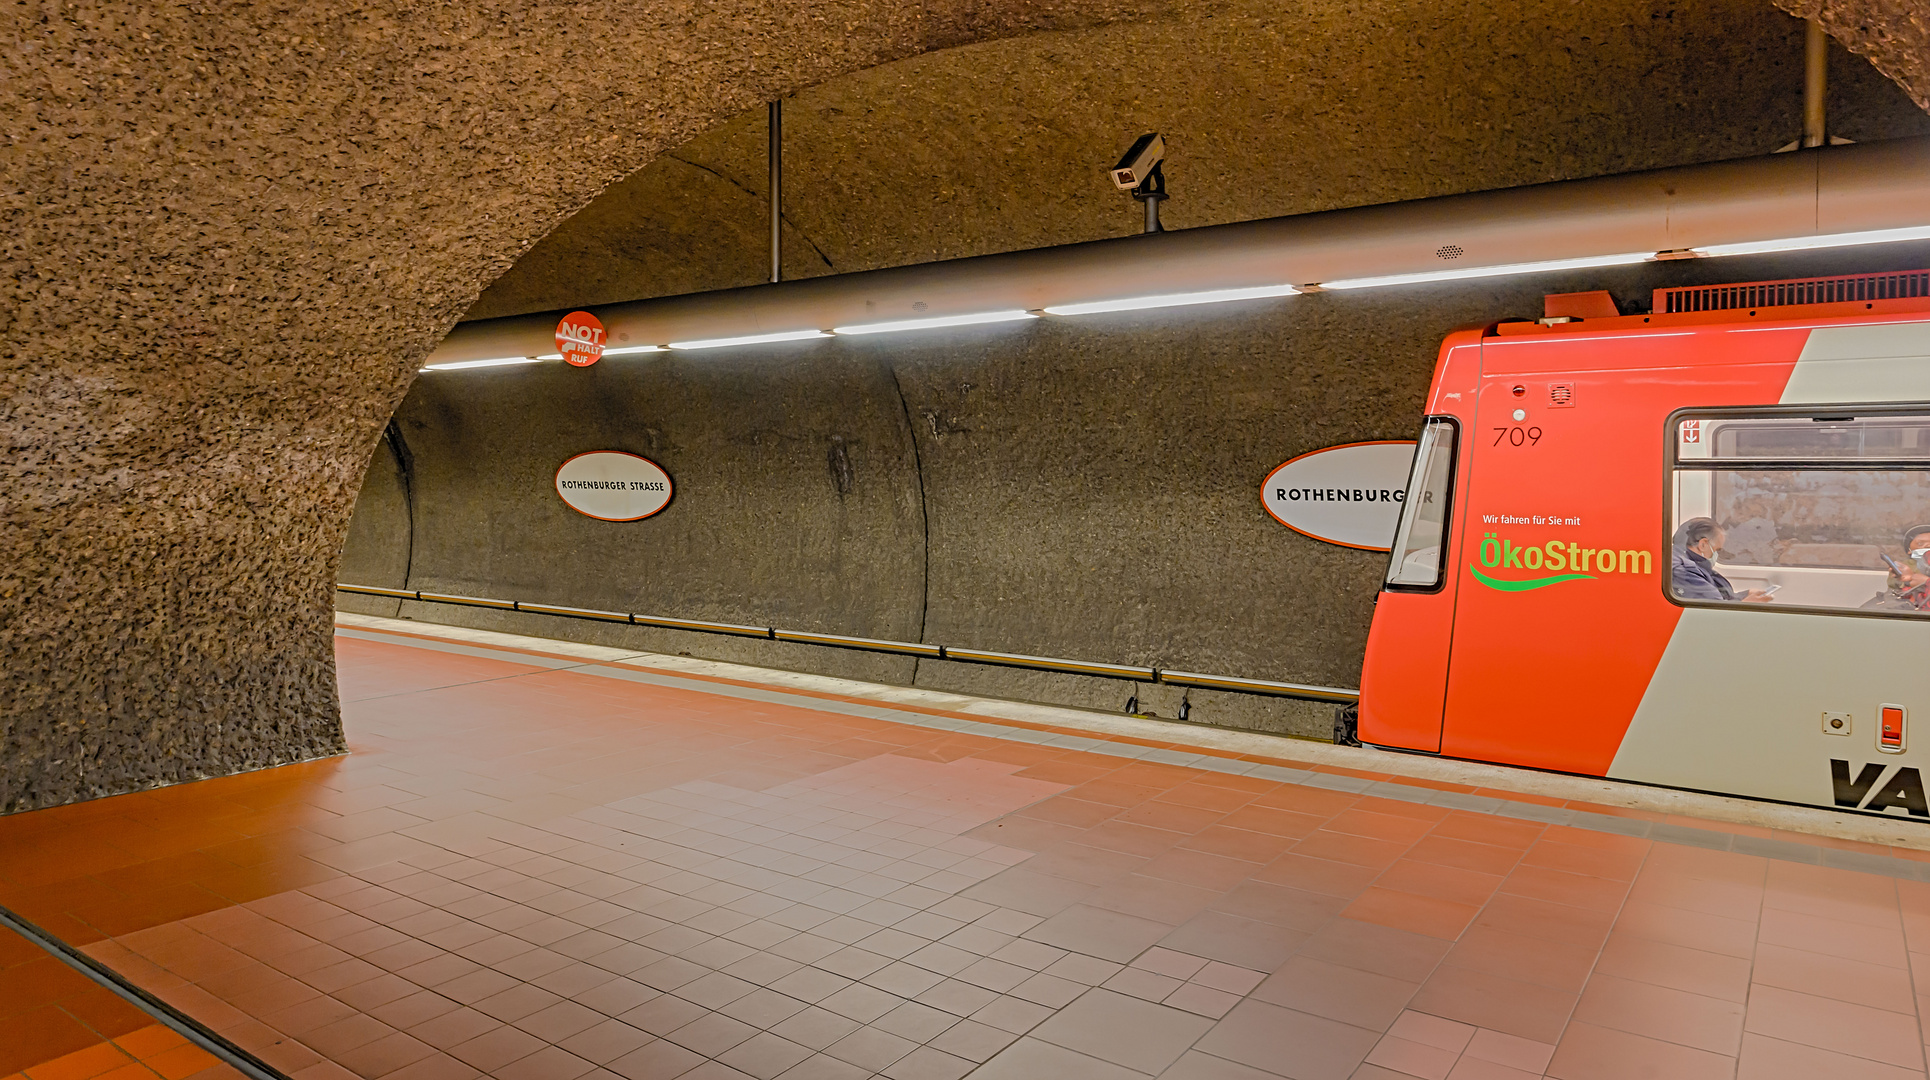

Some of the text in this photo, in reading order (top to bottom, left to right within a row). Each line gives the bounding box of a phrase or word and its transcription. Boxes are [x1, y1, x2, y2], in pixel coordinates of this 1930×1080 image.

[561, 321, 603, 344] NOT
[577, 344, 600, 355] HALT
[571, 353, 588, 364] RUF
[1493, 426, 1543, 447] 709
[561, 480, 665, 492] ROTHENBURGER STRASSE
[1276, 488, 1433, 504] ROTHENBURGR
[1482, 514, 1581, 526] Wir fahren für Sie mit
[1480, 532, 1652, 575] ÖkoStrom
[1830, 758, 1930, 818] VA
